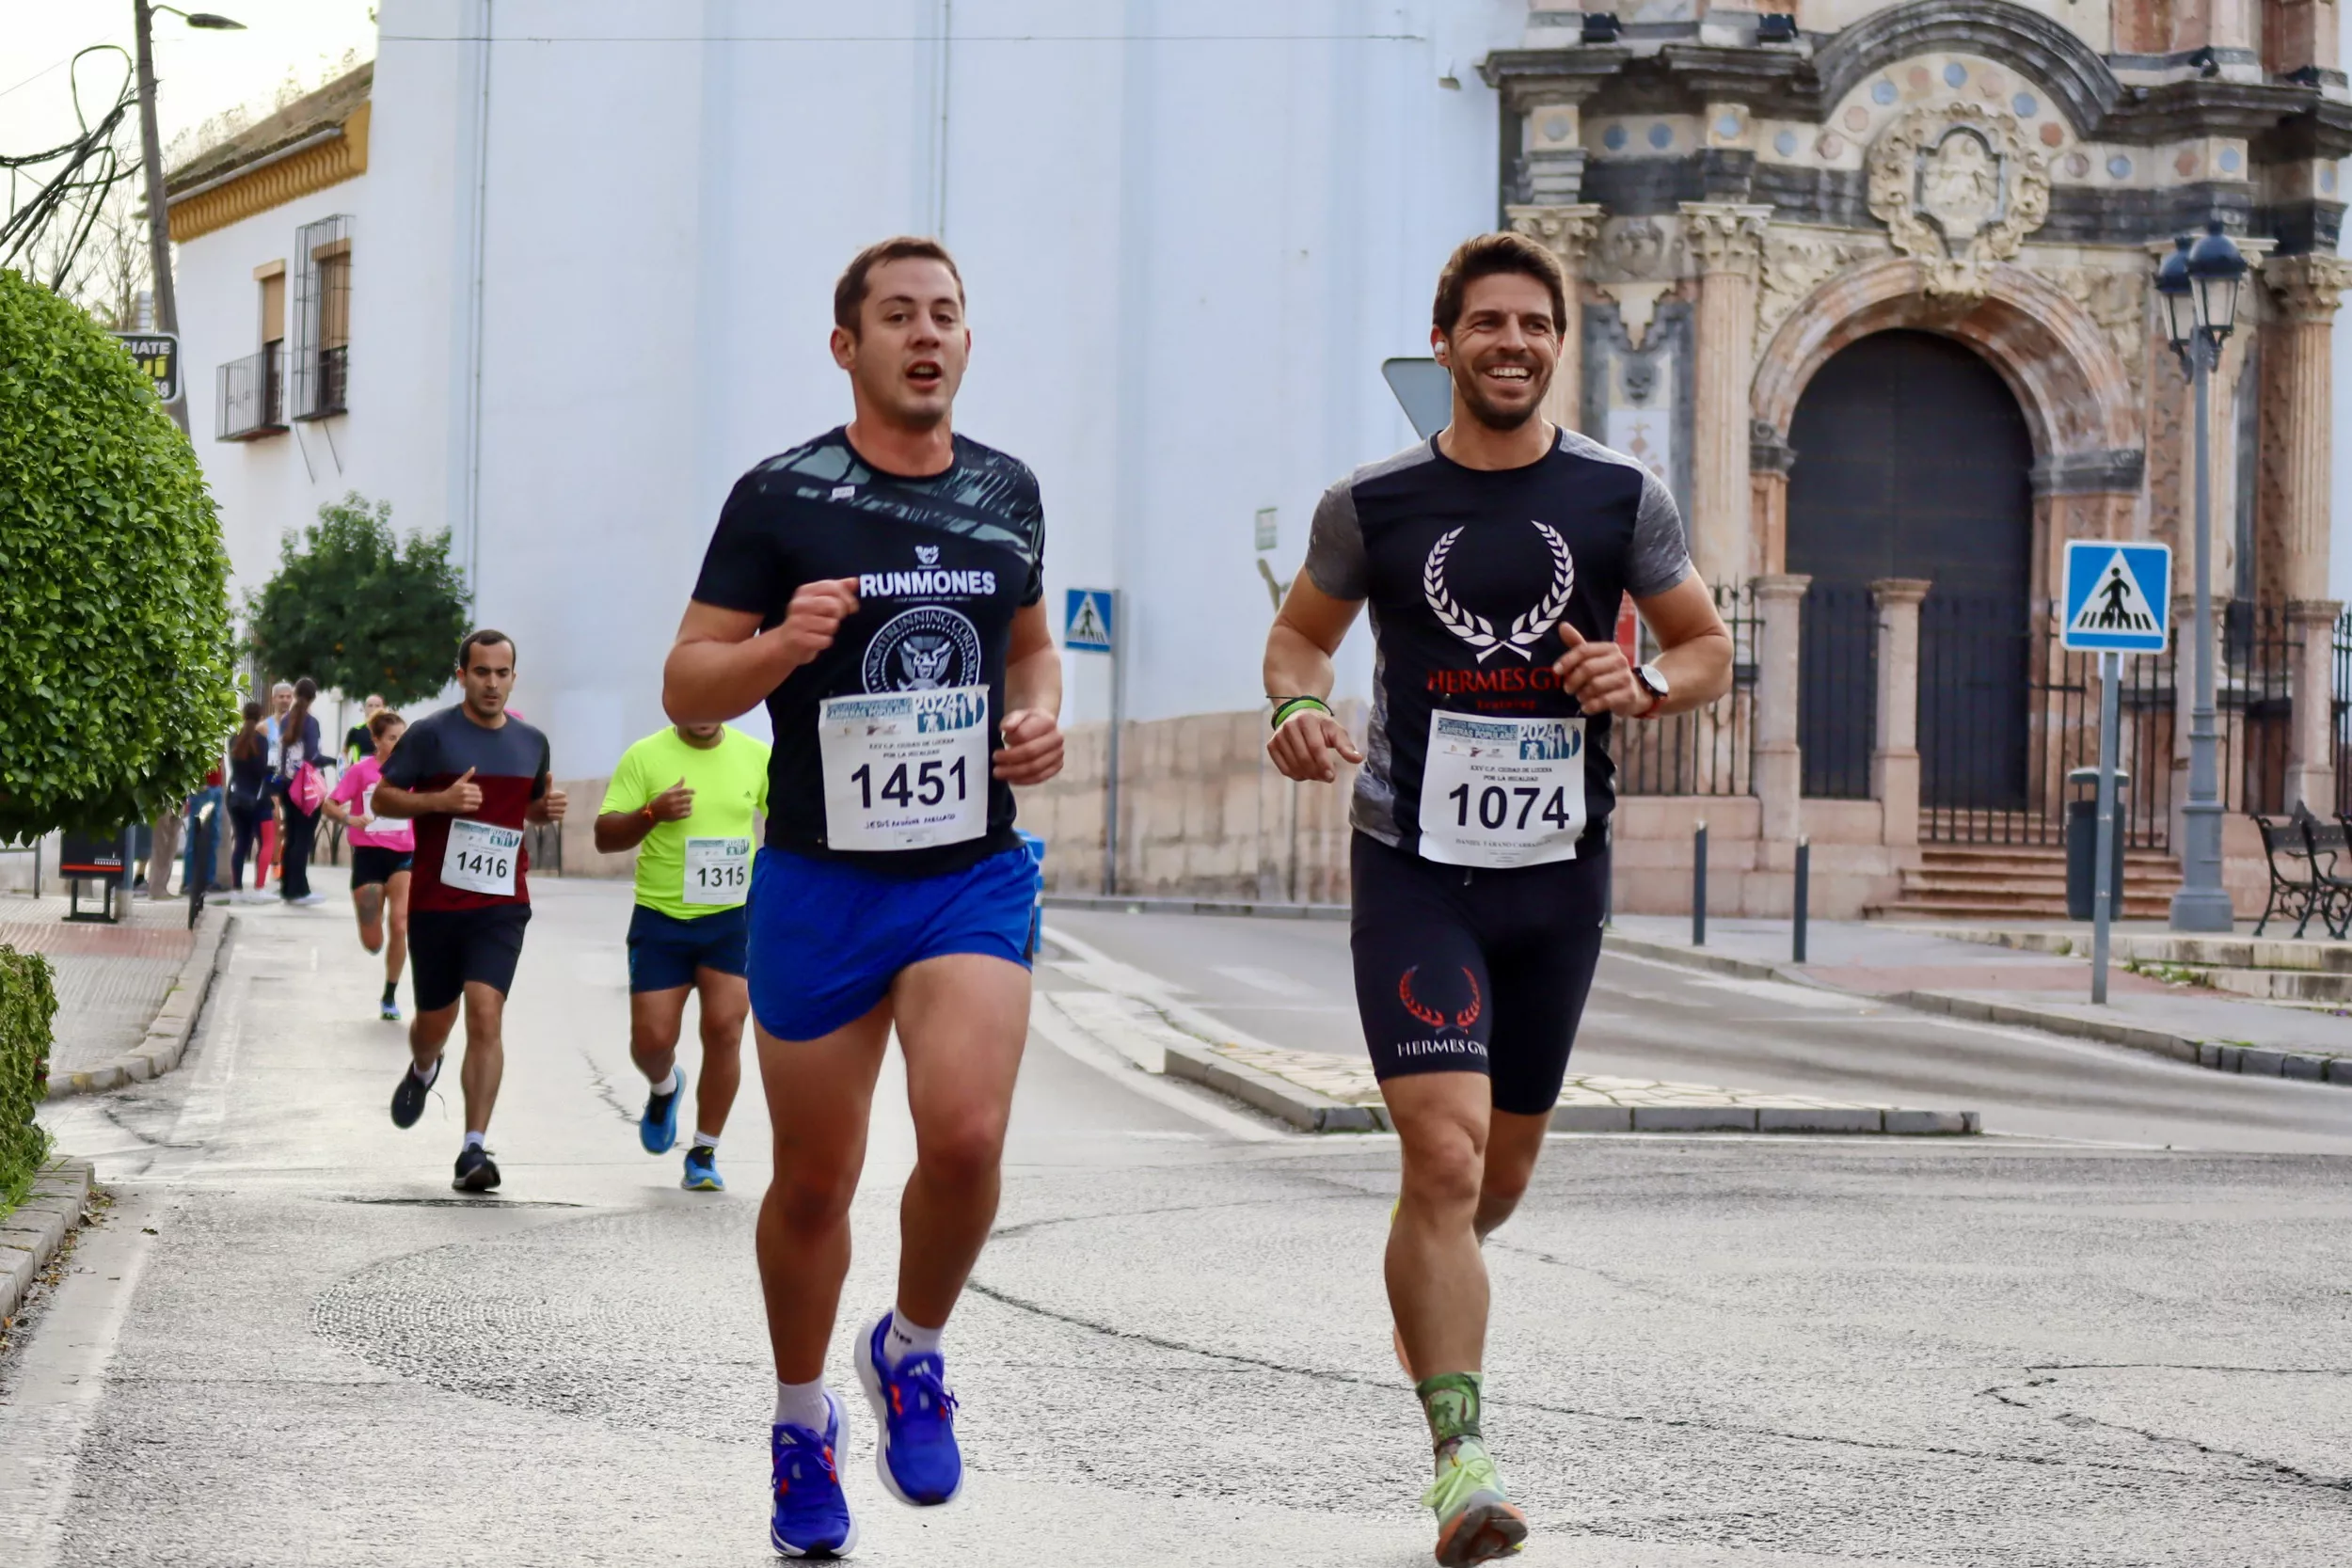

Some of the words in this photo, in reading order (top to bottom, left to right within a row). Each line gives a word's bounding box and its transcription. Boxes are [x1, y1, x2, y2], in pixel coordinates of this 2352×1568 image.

[860, 571, 996, 597] RUNMONES
[885, 610, 952, 638] RUNNING
[1426, 669, 1526, 693] HERMES
[1529, 667, 1563, 691] GY
[916, 692, 958, 715] 2024
[1519, 722, 1556, 742] 2024
[850, 755, 966, 809] 1451
[1449, 783, 1570, 830] 1074
[457, 851, 508, 879] 1416
[697, 866, 745, 887] 1315
[1397, 1038, 1465, 1057] HERMES
